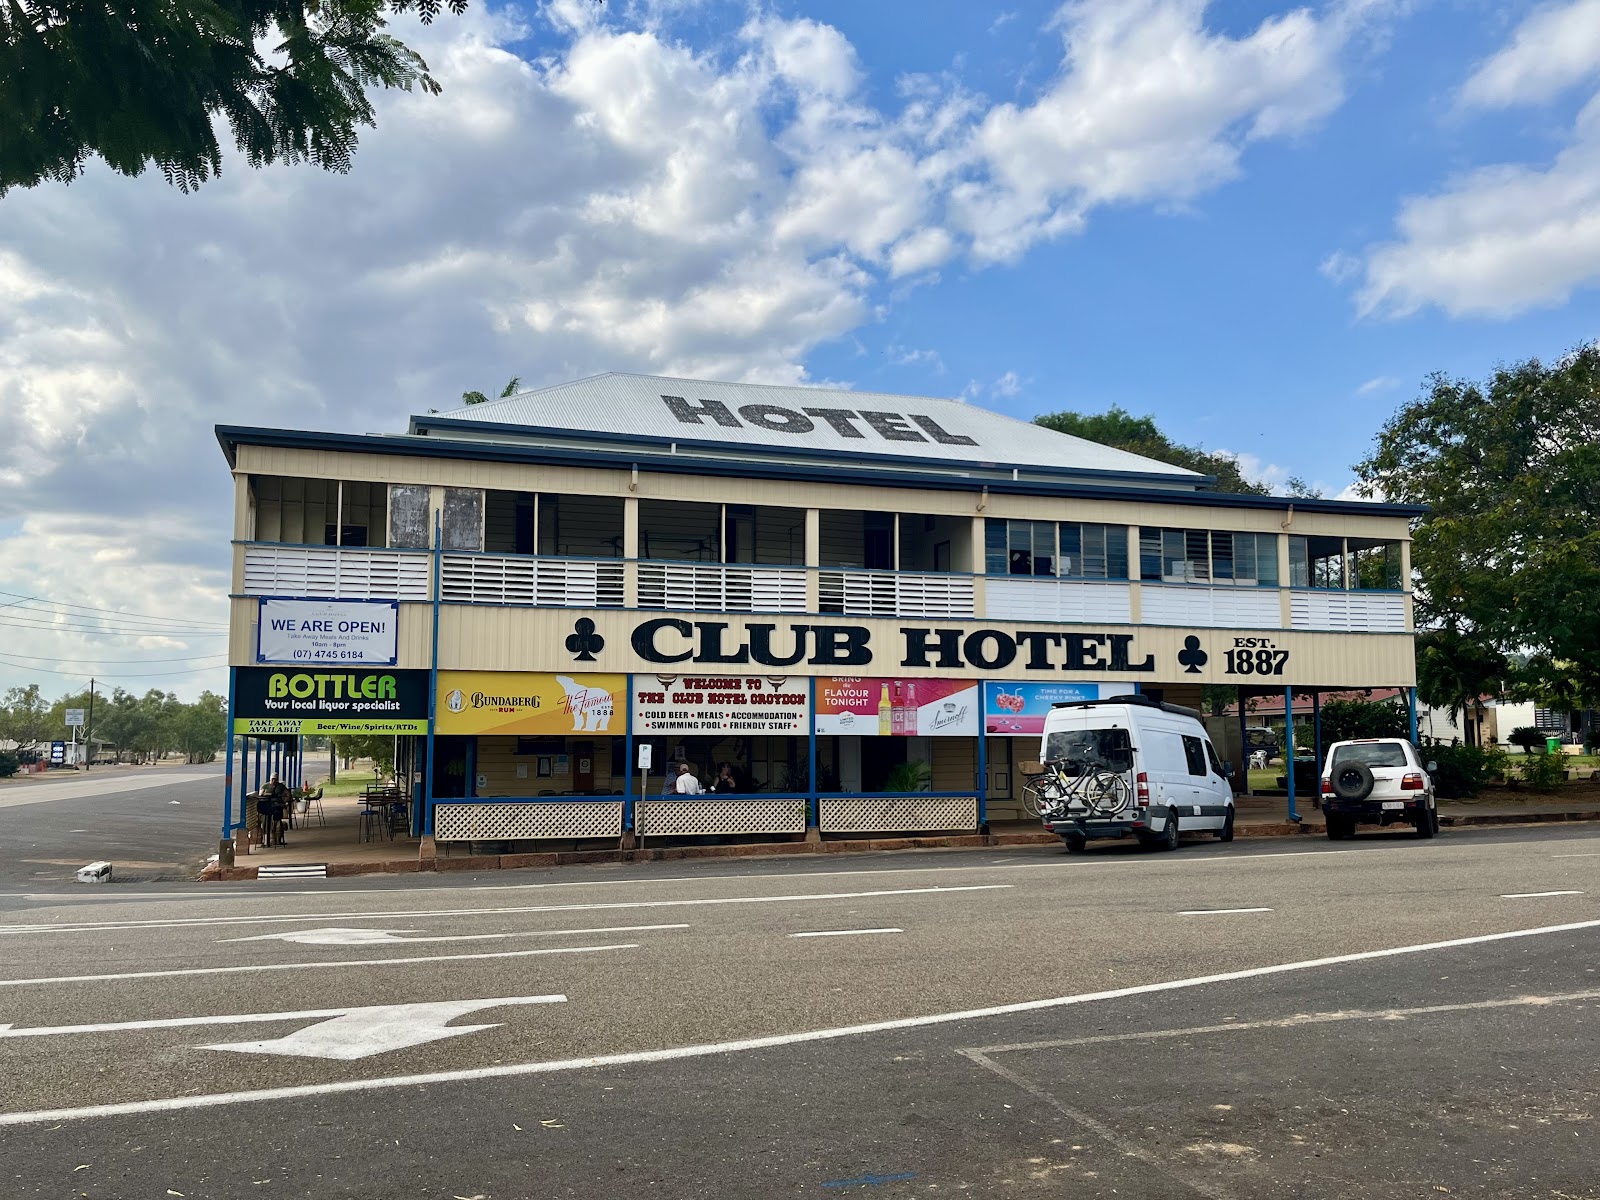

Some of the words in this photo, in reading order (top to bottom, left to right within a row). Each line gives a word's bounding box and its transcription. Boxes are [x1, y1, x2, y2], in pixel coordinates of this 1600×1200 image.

[660, 394, 980, 447] HOTEL
[271, 619, 296, 631] WE
[300, 620, 333, 632] ARE
[338, 621, 385, 634] OPEN!
[302, 633, 318, 641] Away
[1233, 637, 1276, 649] EST.
[631, 617, 873, 667] CLUB
[900, 627, 1155, 672] HOTEL
[293, 649, 312, 659] (07)
[314, 650, 338, 659] 4745
[340, 651, 363, 659] 6184
[1223, 648, 1290, 676] 1887
[268, 673, 396, 699] BOTTLER
[683, 678, 742, 690] WELCOME
[746, 679, 762, 690] TO
[638, 692, 665, 704] THE
[672, 693, 704, 704] CLUB
[707, 693, 747, 705] HOTEL
[750, 694, 806, 705] CROYDON
[824, 689, 869, 697] FLAVOUR
[264, 699, 289, 710] Your
[291, 699, 316, 710] local
[319, 700, 350, 712] liquor
[352, 700, 401, 712] specialist
[557, 694, 578, 715] The
[574, 690, 614, 716] Famous
[825, 698, 869, 706] TONIGHT
[645, 711, 666, 719] COLD
[668, 711, 689, 719] BEER
[731, 711, 797, 720] ACCOMMODATION
[317, 722, 418, 731] Beer/Wine/Spirits/RTDs
[651, 721, 699, 729] SWIMMING
[701, 721, 721, 729] POOL
[729, 722, 766, 730] FRIENDLY
[768, 722, 792, 730] STAFF
